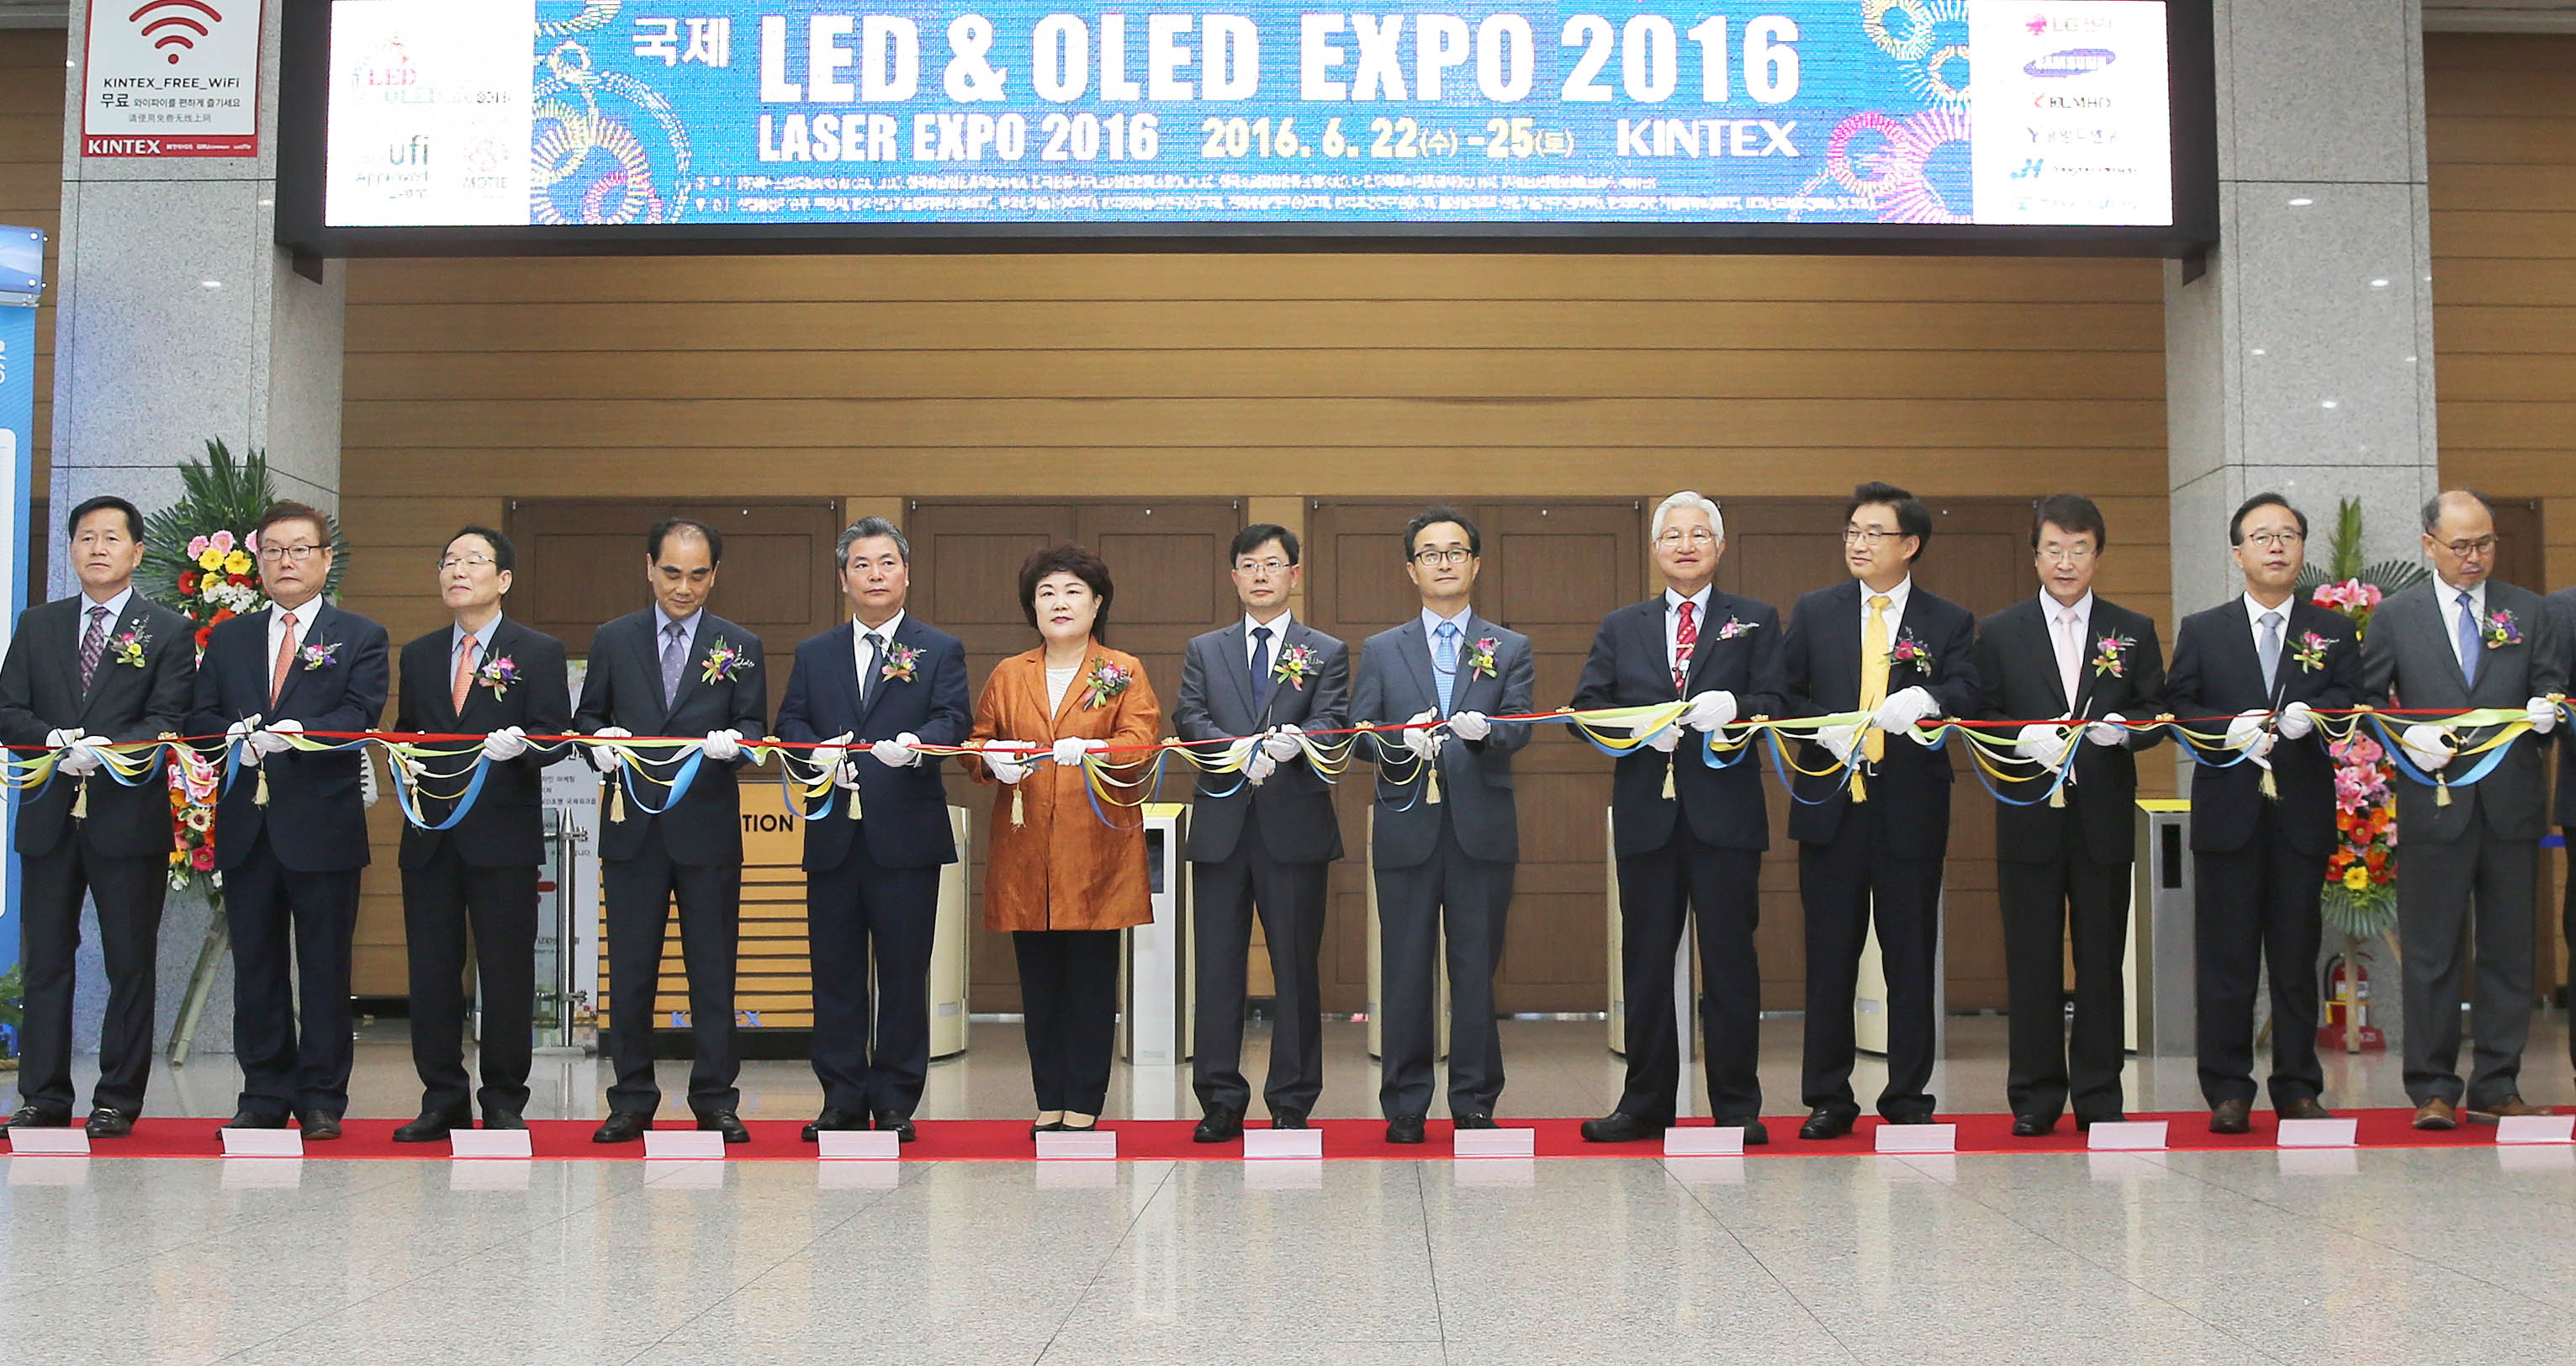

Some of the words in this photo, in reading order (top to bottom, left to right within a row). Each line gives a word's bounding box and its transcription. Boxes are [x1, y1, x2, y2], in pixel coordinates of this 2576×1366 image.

[632, 16, 732, 68] 국제
[760, 14, 920, 103] LED
[944, 13, 1006, 103] &
[1032, 13, 1260, 103] OLED
[1301, 13, 1535, 103] EXPO
[1560, 14, 1801, 103] 2016
[103, 77, 241, 90] KINTEX_FREE_WiFi
[100, 93, 130, 109] 무료
[134, 98, 176, 109] 와이파이를
[179, 98, 204, 109] 편하게
[207, 98, 241, 109] 즐기세요
[88, 140, 161, 155] KINTEX
[759, 114, 898, 162] LASER
[913, 114, 1025, 161] EXPO
[1040, 113, 1160, 161] 2016
[1201, 117, 1311, 159] 2016.
[1322, 117, 1358, 159] 6.
[1616, 119, 1801, 158] KINTEX
[742, 814, 794, 832] TION
